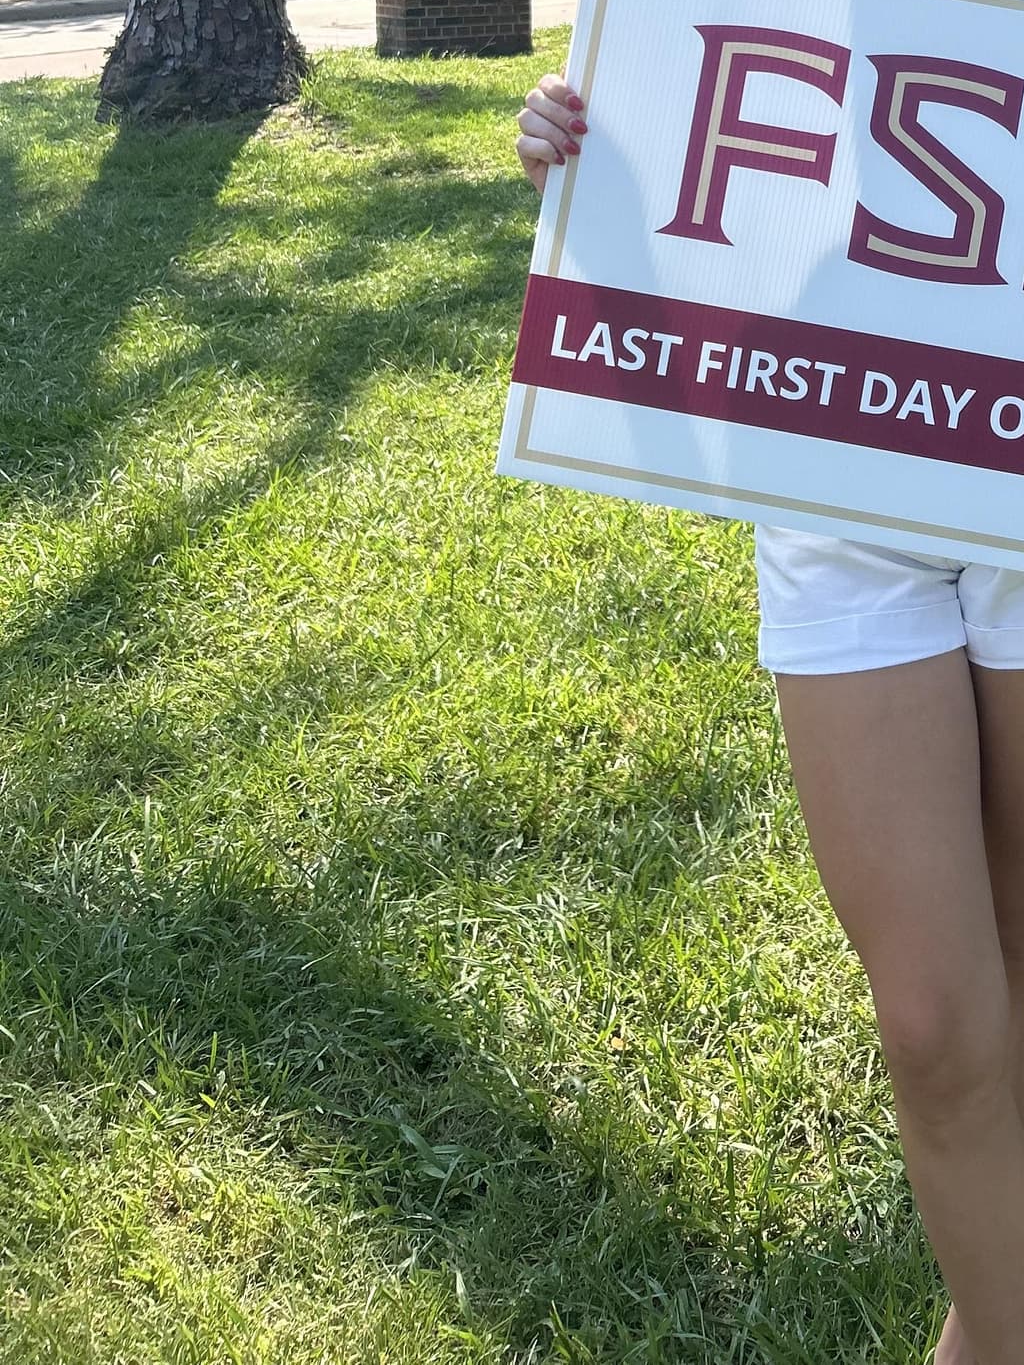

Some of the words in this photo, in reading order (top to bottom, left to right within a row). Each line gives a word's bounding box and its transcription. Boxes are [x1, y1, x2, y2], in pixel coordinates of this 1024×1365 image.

[550, 314, 684, 377] LAST
[695, 340, 847, 406] FIRST
[859, 370, 977, 430] DAY
